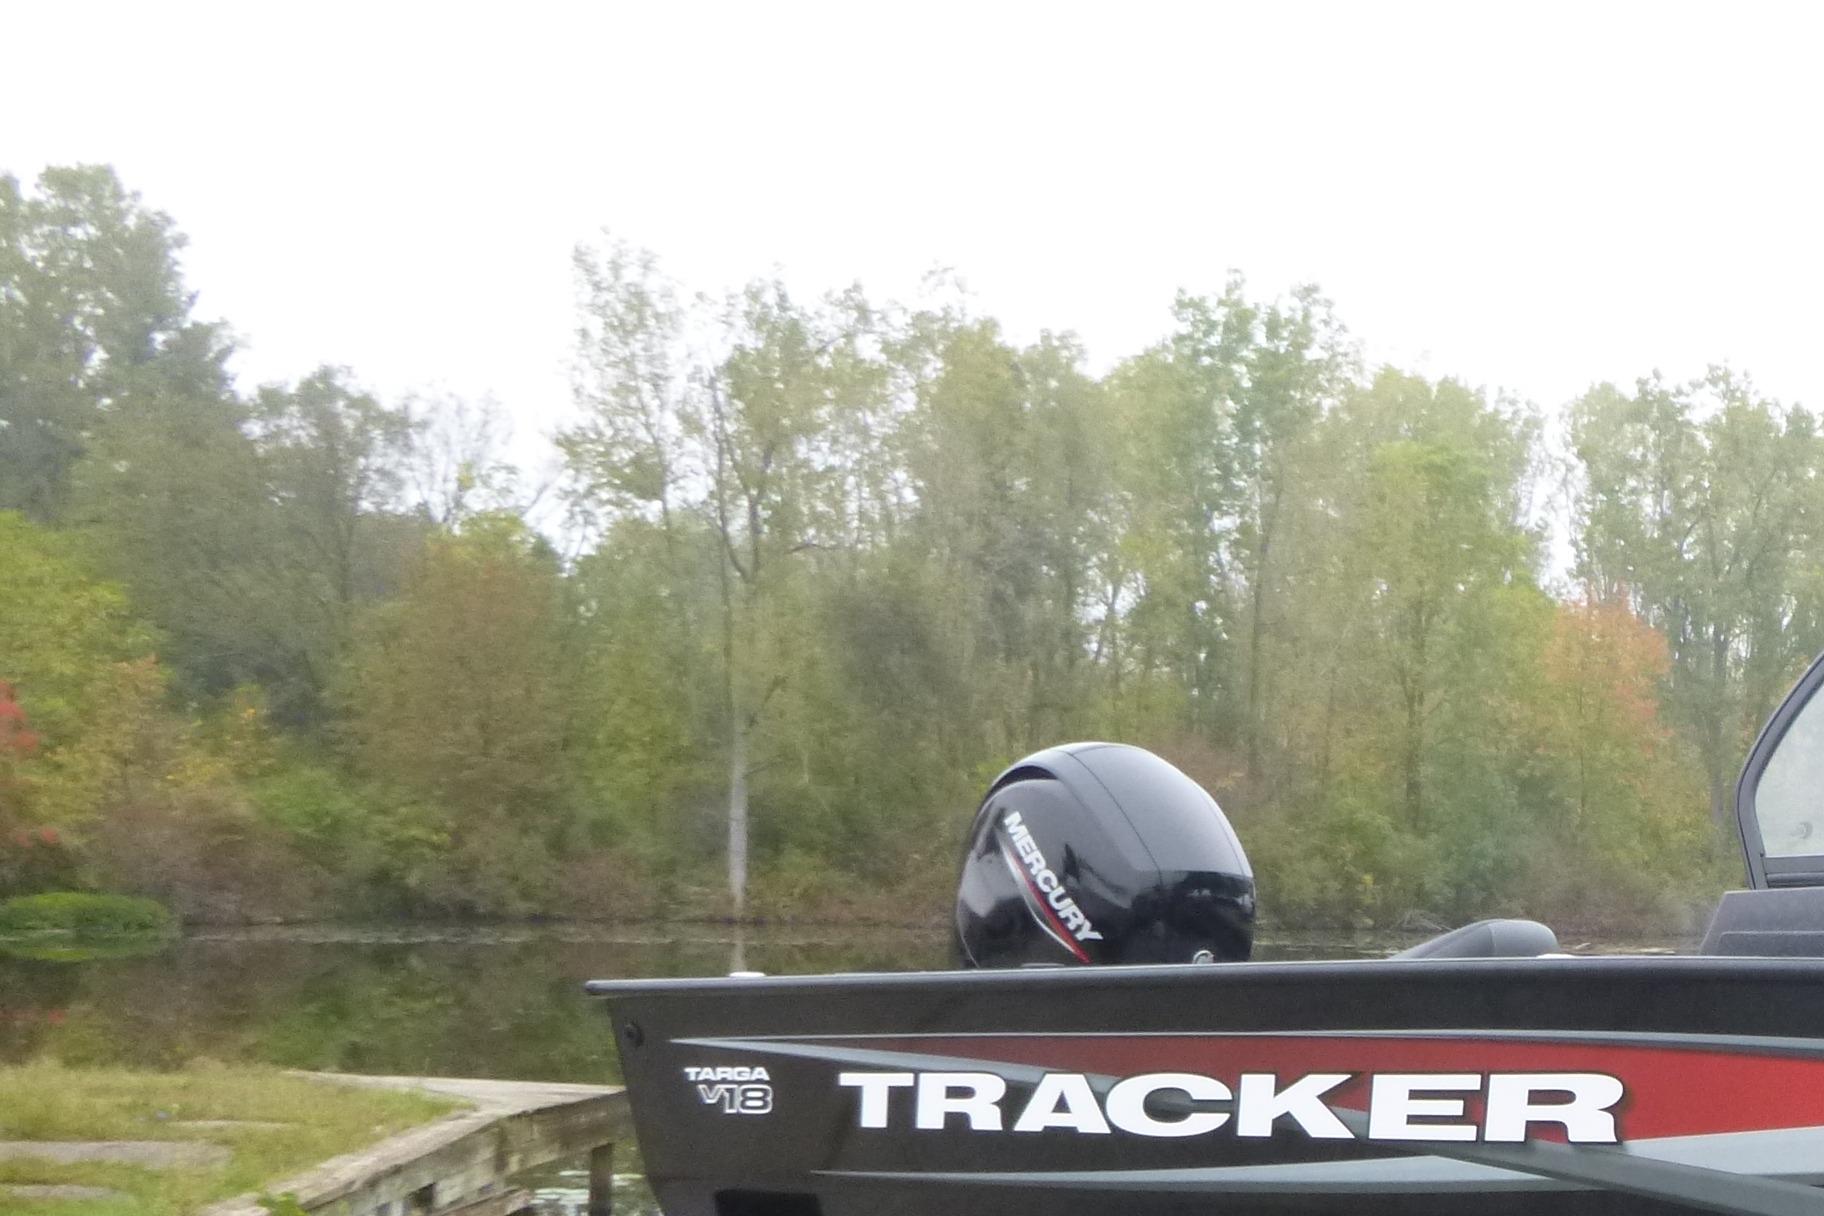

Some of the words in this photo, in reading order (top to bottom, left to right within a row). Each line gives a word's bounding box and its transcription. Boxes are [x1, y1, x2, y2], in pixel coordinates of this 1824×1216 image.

[1003, 811, 1103, 941] MERCURY
[684, 1067, 771, 1081] TARGA
[698, 1084, 773, 1114] V18
[838, 1072, 1626, 1144] TRACKER
